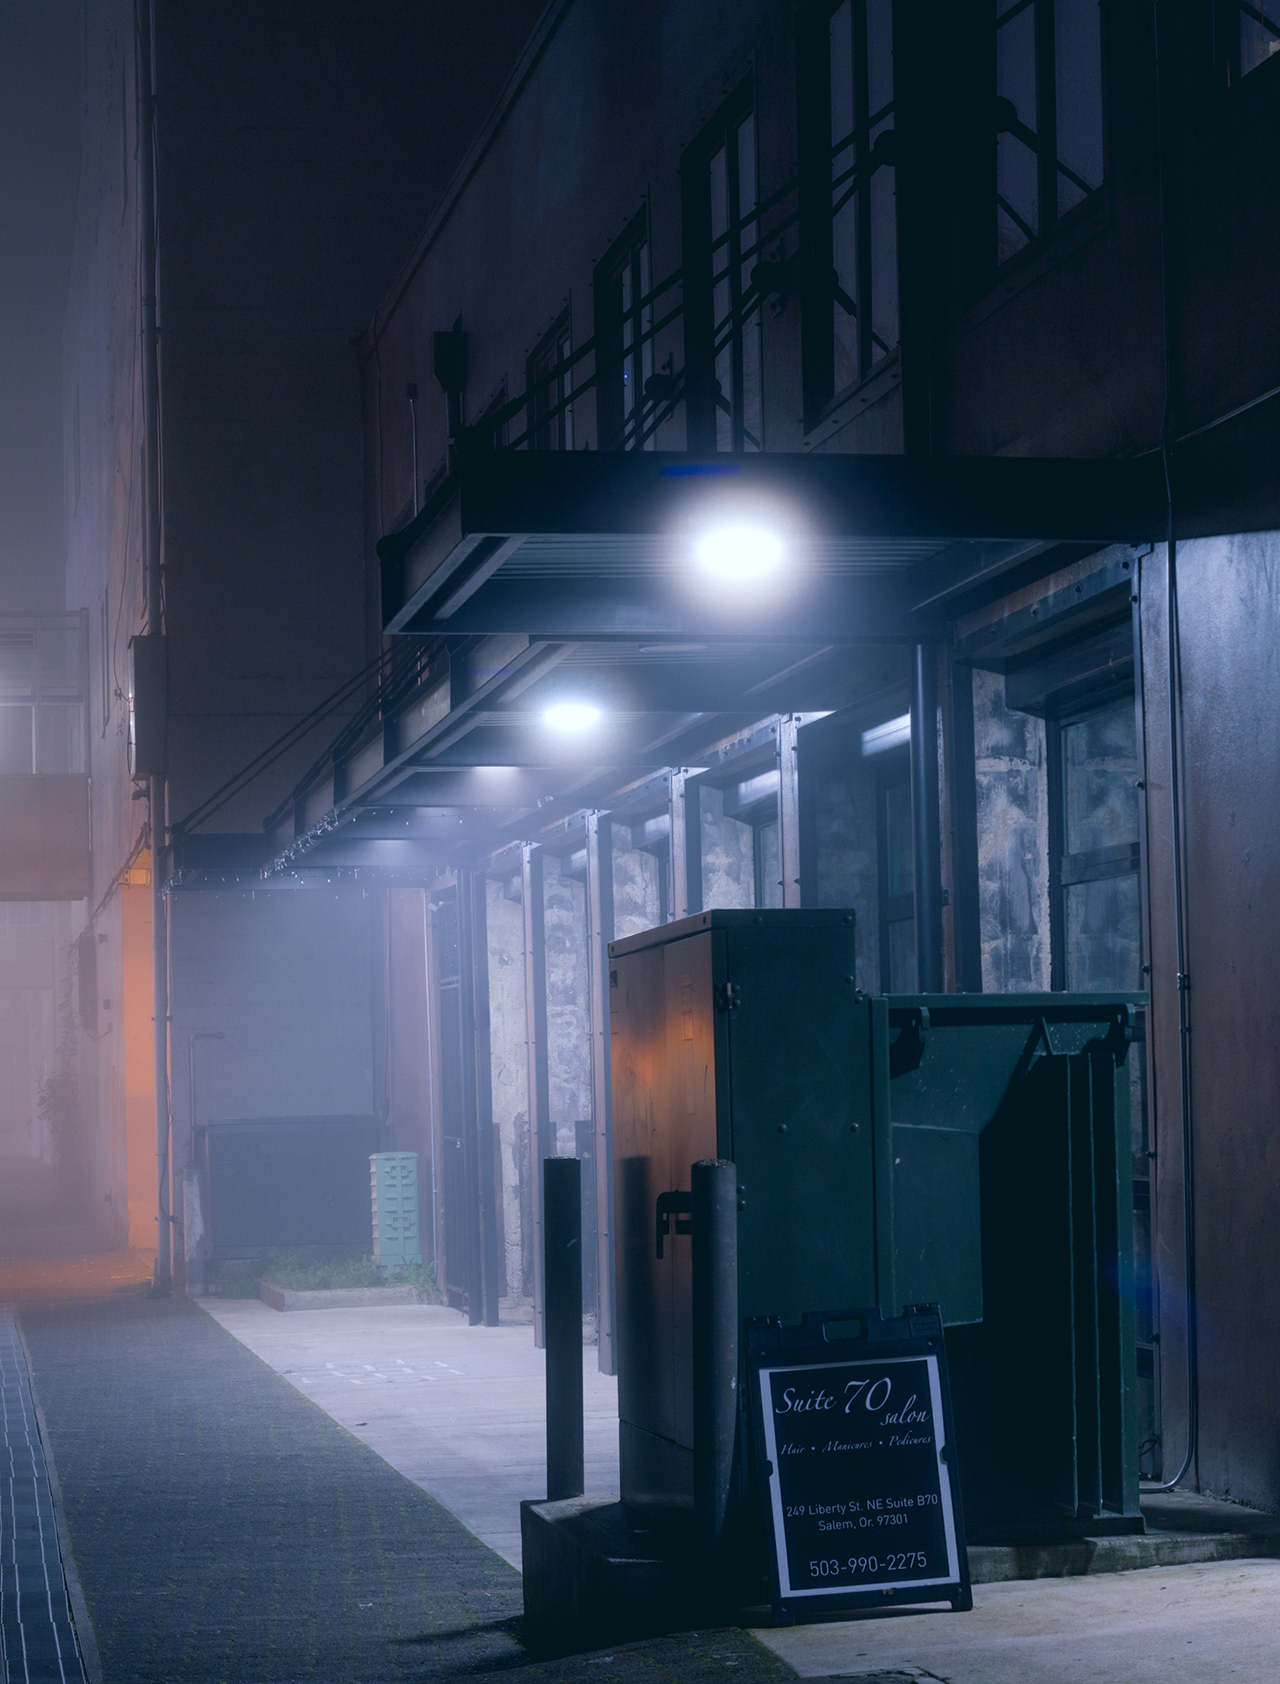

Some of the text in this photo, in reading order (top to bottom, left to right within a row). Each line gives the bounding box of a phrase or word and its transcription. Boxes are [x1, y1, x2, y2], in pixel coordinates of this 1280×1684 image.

[775, 1376, 892, 1414] Suite 70
[880, 1394, 931, 1426] salon
[780, 1429, 932, 1456] Hair Manicures Pedicures
[786, 1493, 939, 1517] 249 Liberty St. NE Suite B70
[818, 1513, 909, 1532] Salem, Or. 97301
[809, 1551, 928, 1578] 503-990-2275
